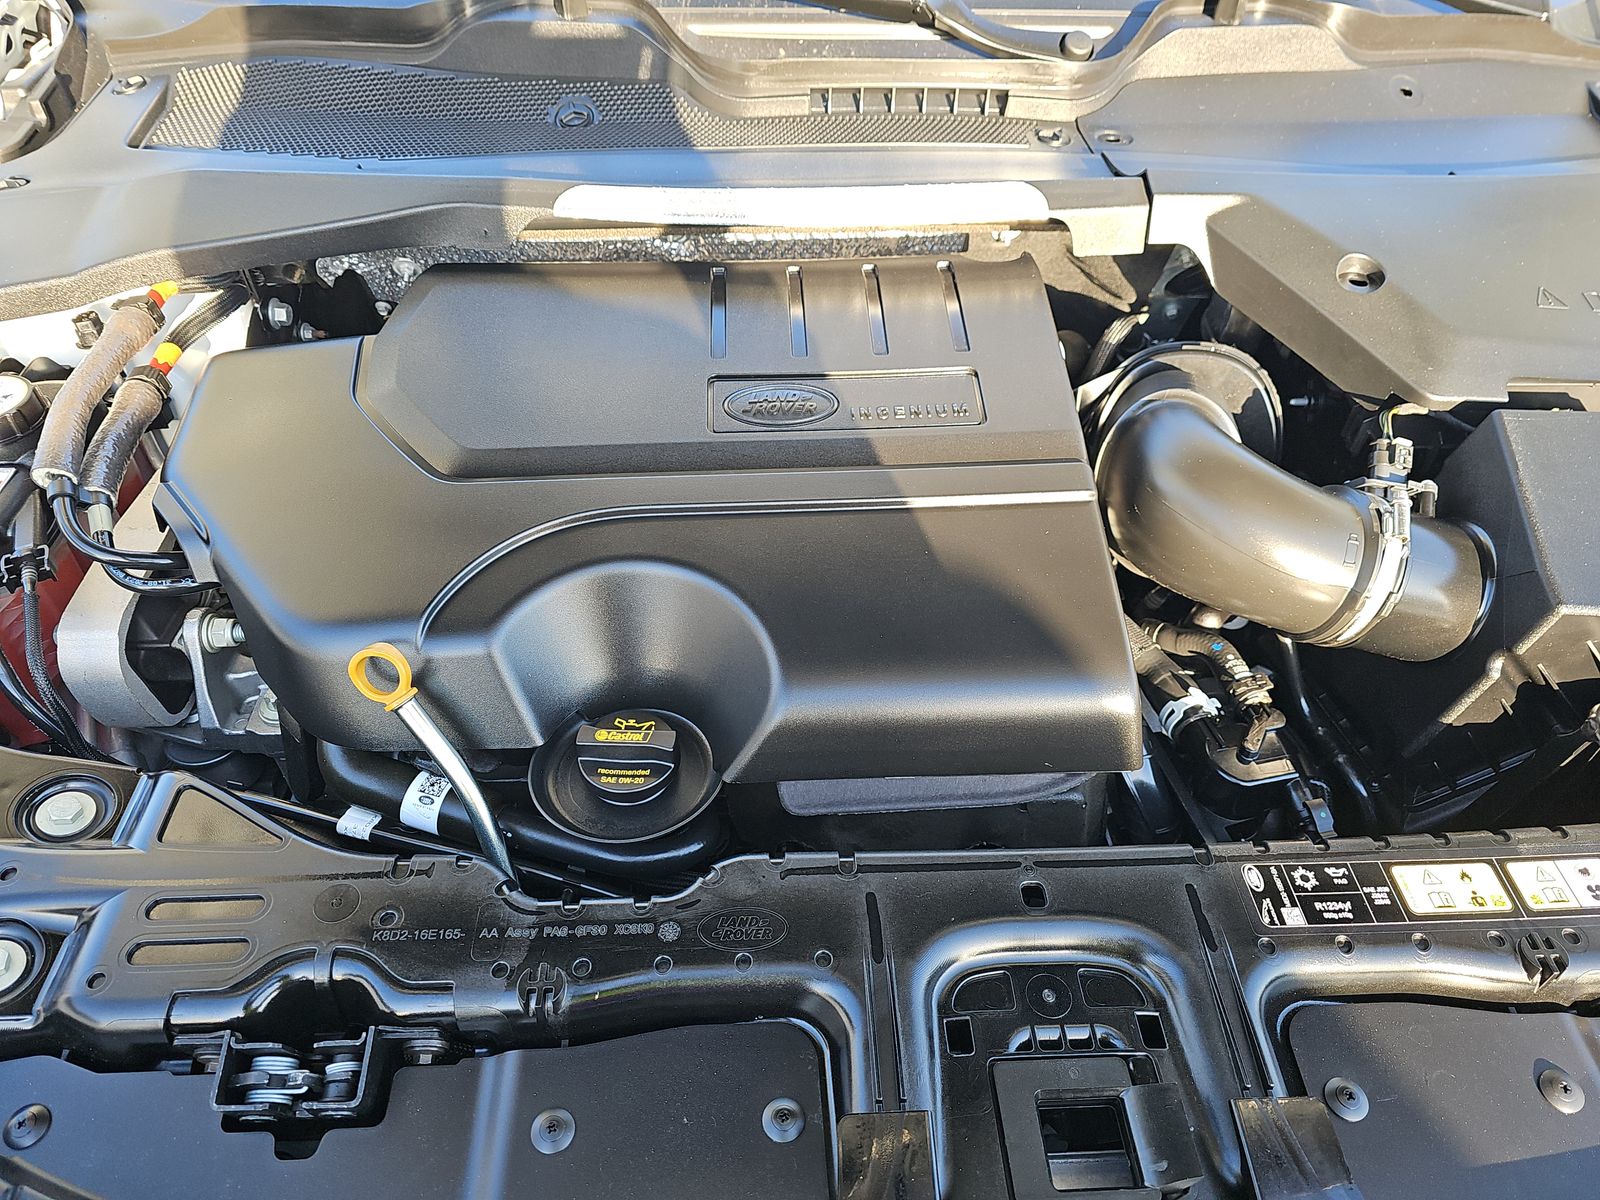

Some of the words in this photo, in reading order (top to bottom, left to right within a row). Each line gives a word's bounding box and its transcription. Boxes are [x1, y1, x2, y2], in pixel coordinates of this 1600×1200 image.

[748, 391, 804, 404] LAND
[750, 402, 818, 417] ROVER
[850, 402, 970, 421] INGENIUM
[607, 730, 645, 741] Castrol
[597, 768, 651, 776] recommended
[600, 776, 617, 784] SAE
[618, 776, 645, 784] 0W-20
[1313, 900, 1353, 912] R1234yf
[717, 915, 760, 929] LAND
[372, 927, 466, 942] K8D2-16E165-
[479, 927, 499, 939] AA
[505, 926, 539, 940] Assy
[718, 927, 774, 942] ROVER
